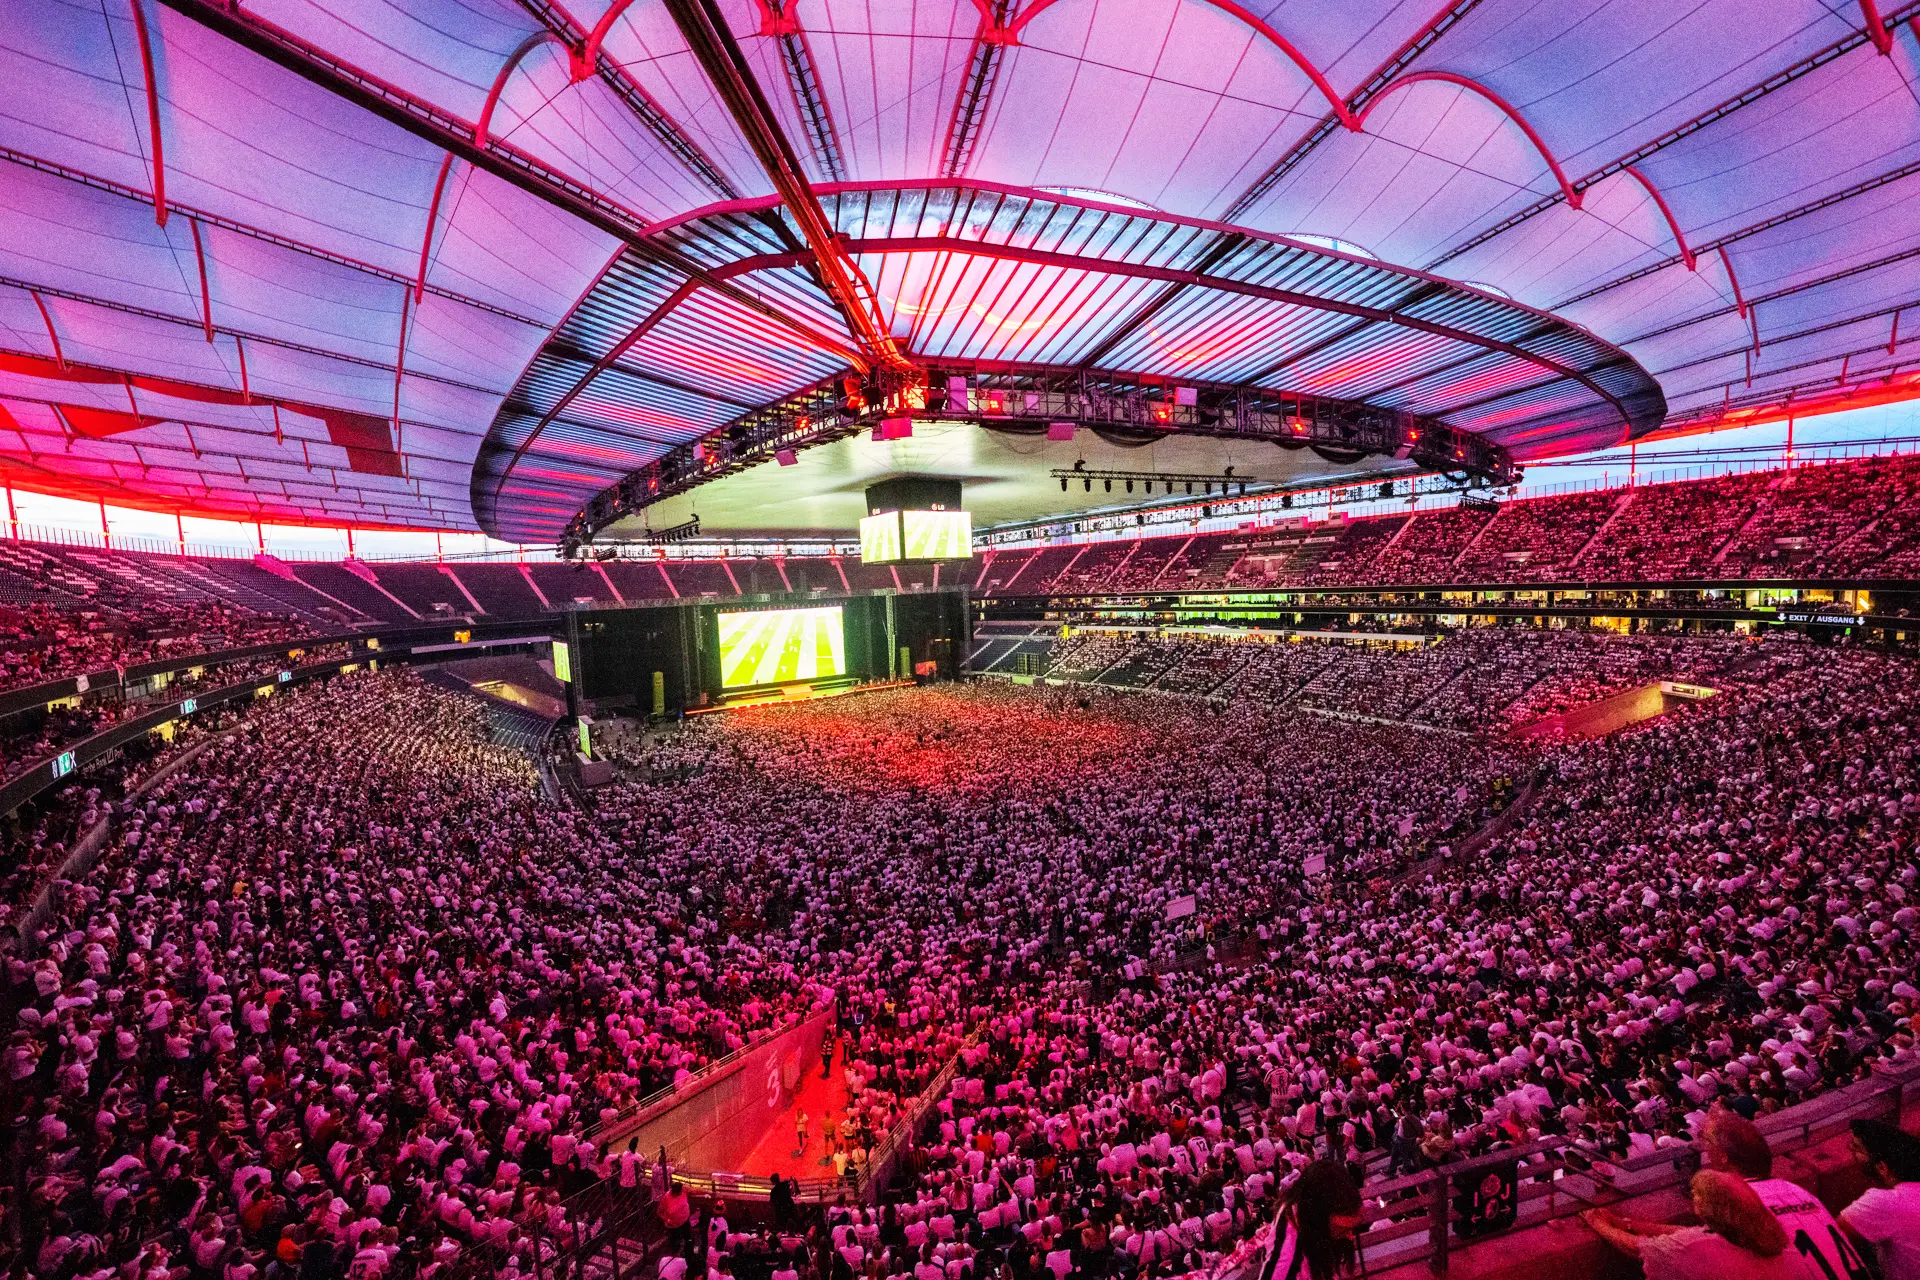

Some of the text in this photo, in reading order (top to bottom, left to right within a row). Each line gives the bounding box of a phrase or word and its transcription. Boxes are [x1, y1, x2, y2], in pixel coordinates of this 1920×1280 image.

[1817, 616, 1854, 624] AUSGANG
[767, 1068, 781, 1108] 3
[1196, 1140, 1207, 1152] 12
[1500, 1183, 1511, 1200] J
